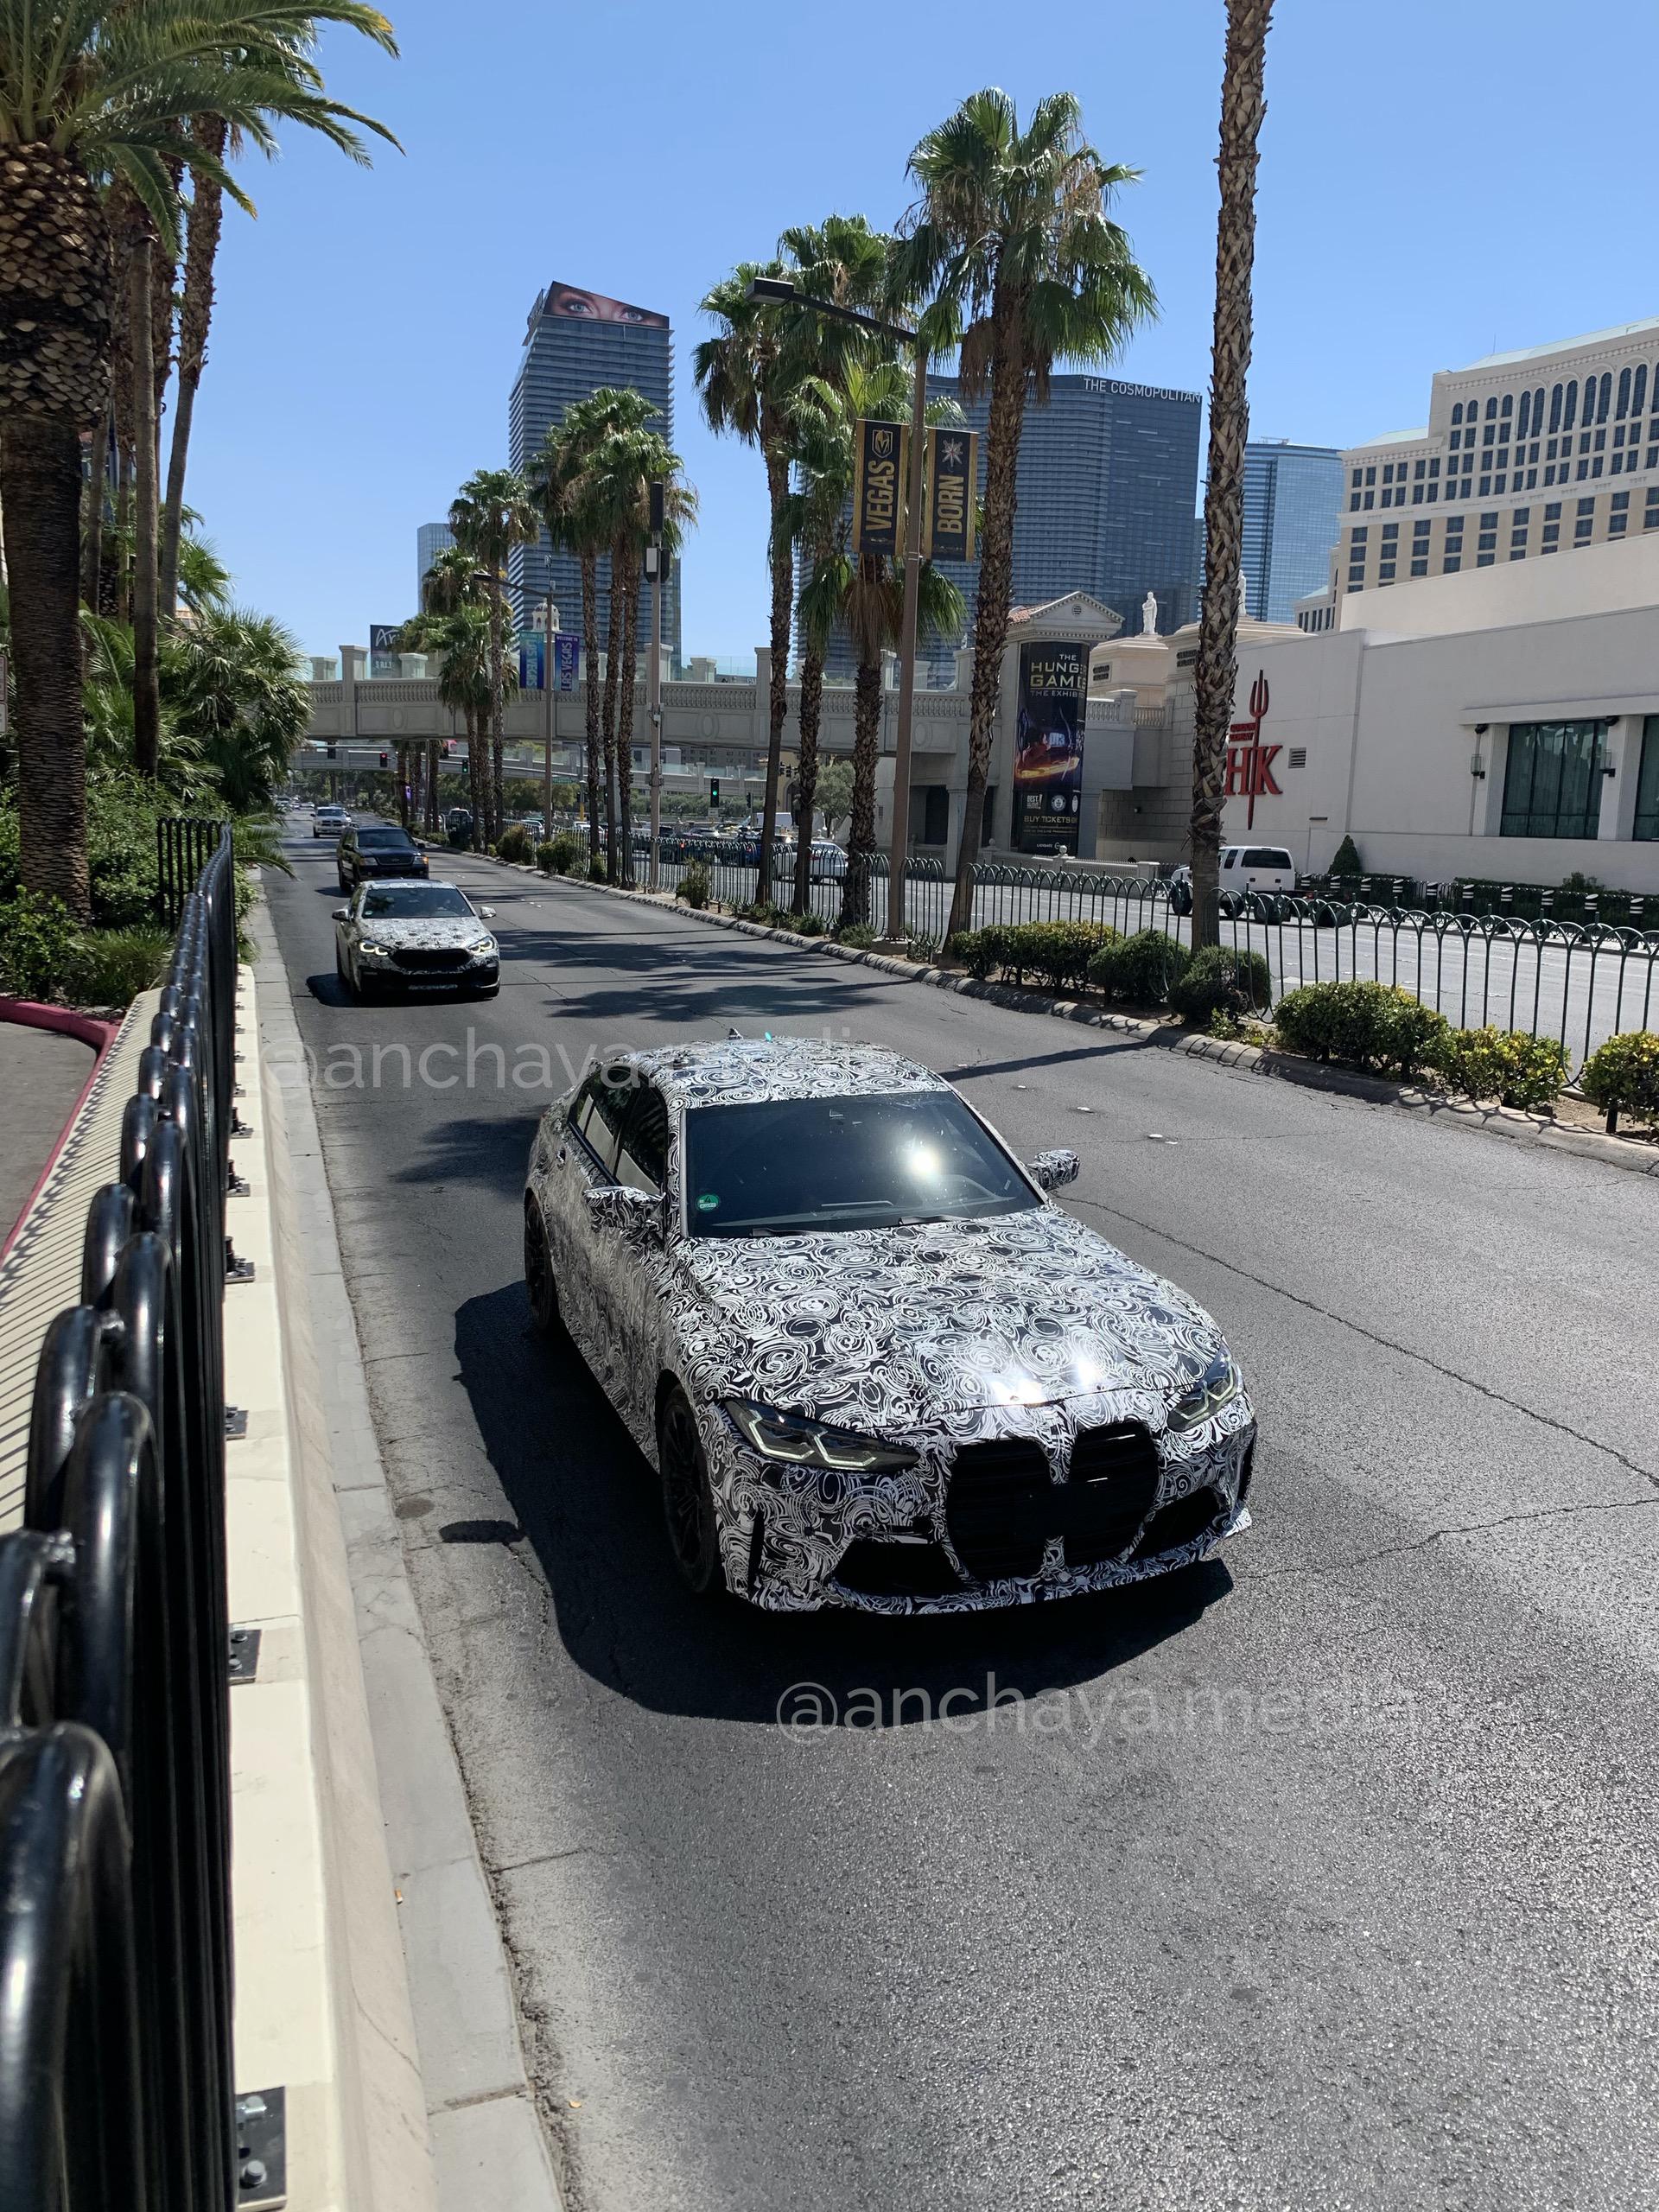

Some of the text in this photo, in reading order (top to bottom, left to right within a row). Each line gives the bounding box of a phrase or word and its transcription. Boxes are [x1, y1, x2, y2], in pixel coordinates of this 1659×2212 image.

[1084, 378, 1201, 404] THE COSMOPOLITAN
[866, 460, 895, 531] VEGAS
[937, 474, 964, 534] BORN
[562, 642, 572, 690] LAS VEGAS
